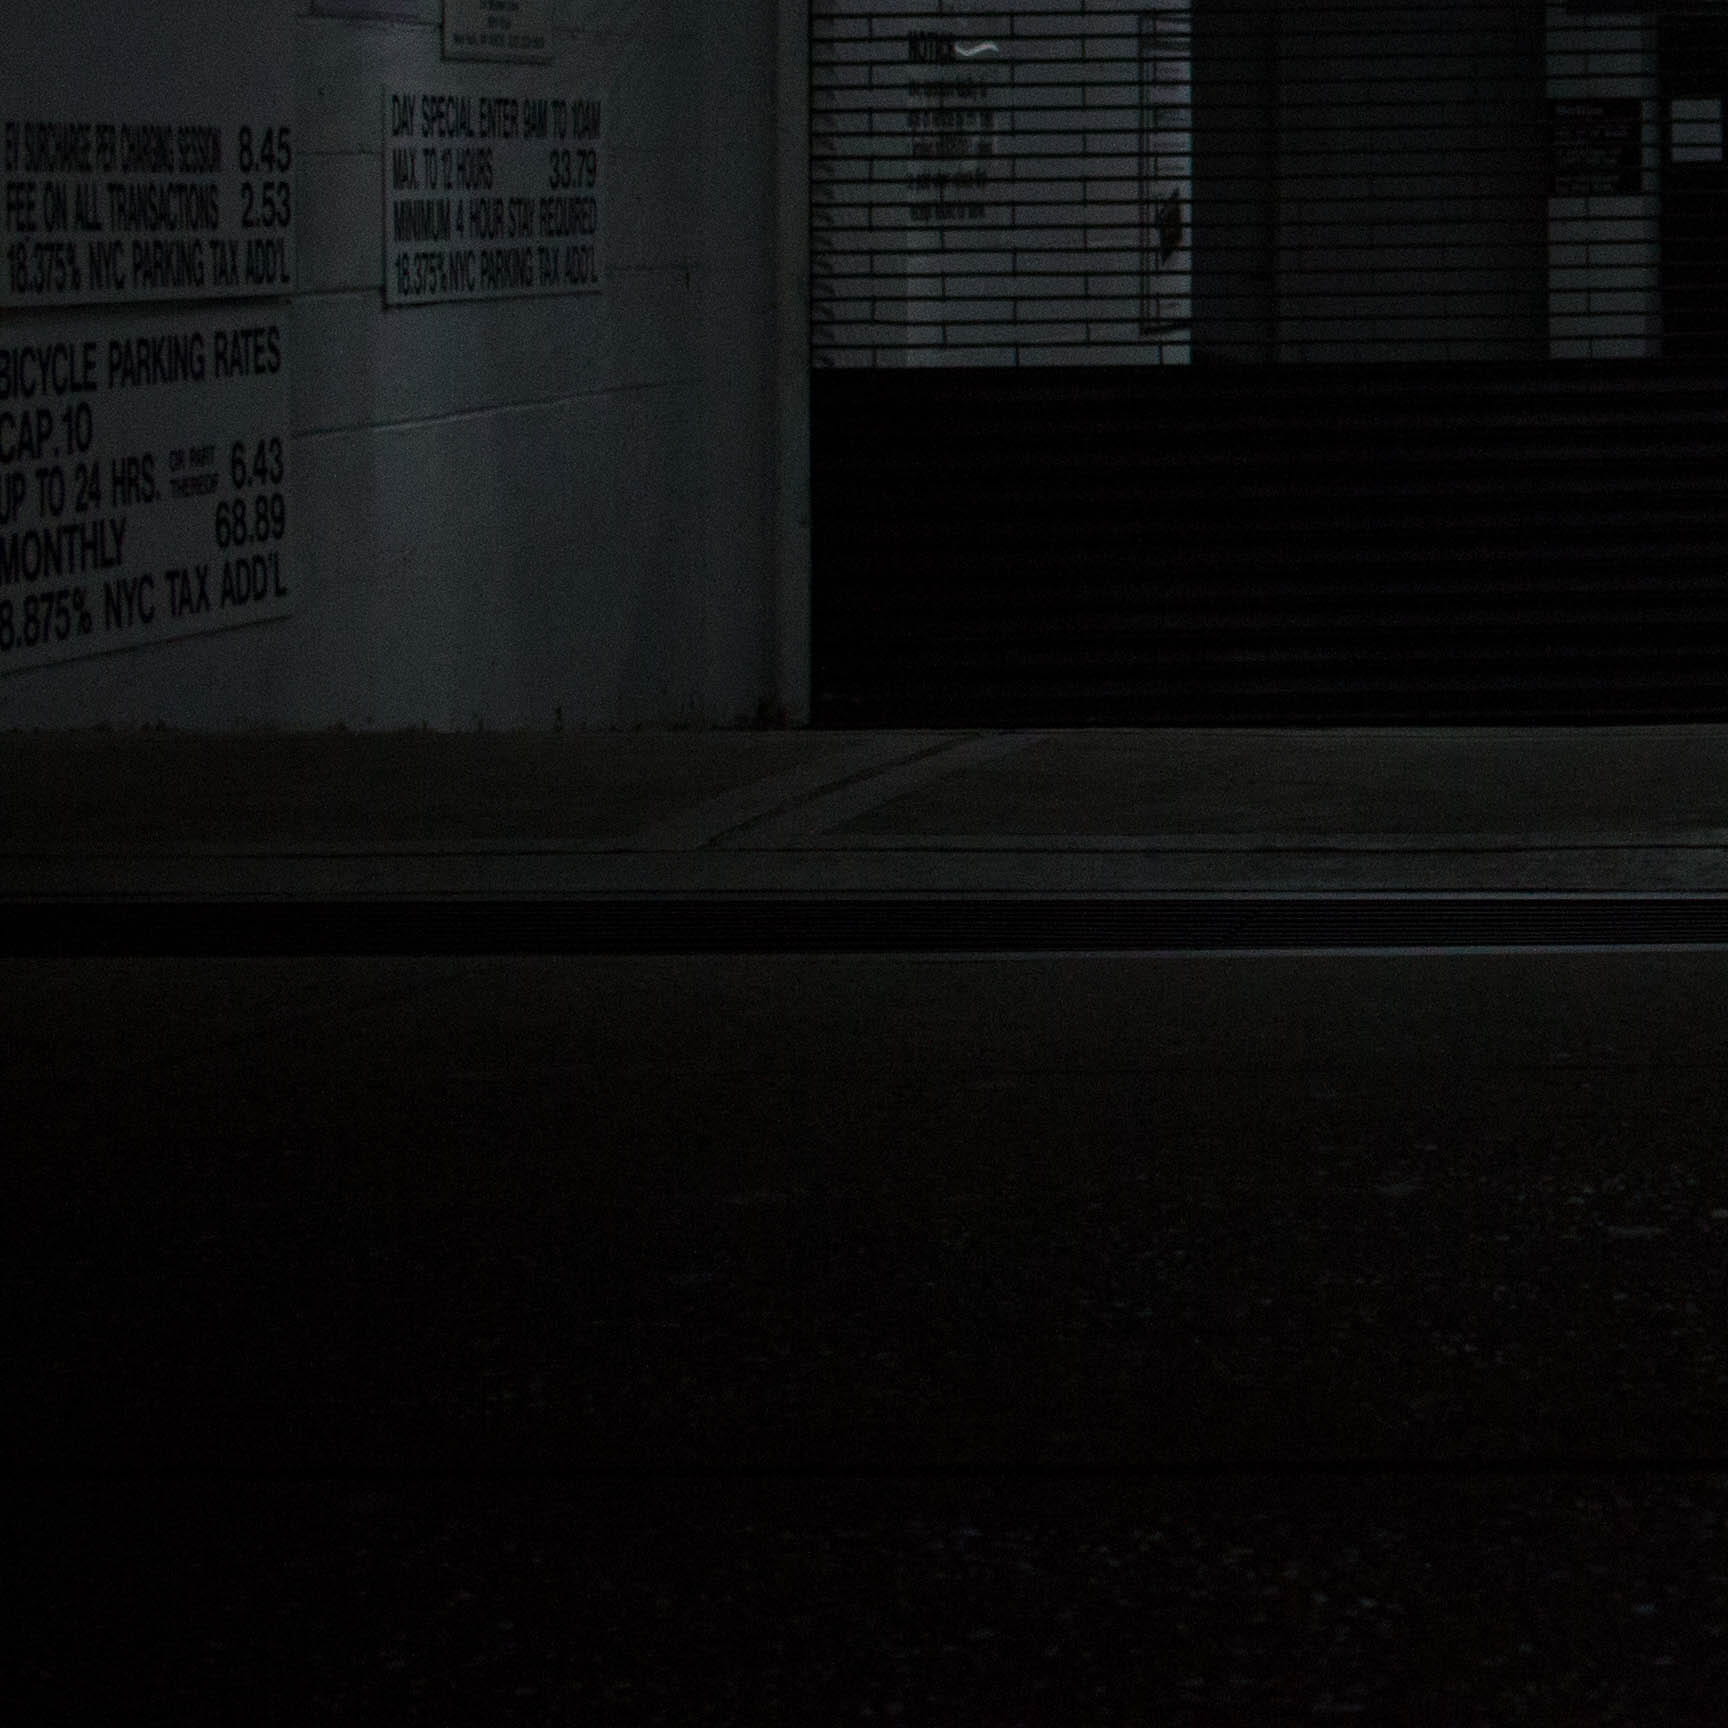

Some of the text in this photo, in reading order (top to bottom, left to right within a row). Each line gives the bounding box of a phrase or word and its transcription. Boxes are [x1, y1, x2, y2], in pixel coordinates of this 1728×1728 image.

[391, 94, 416, 137] DAY
[420, 95, 476, 139] SPECIAL
[478, 96, 519, 140] ENTER
[551, 99, 567, 141] TO
[237, 124, 293, 174] 8.45
[422, 147, 438, 191] TO
[455, 147, 494, 191] HOURS
[548, 147, 599, 191] 33.79
[6, 179, 293, 233] FEE ON ALL TRANSACTIONS 2.53
[392, 198, 451, 243] MINIMUM
[507, 196, 536, 240] STAY
[538, 195, 599, 237] REQUIRED
[88, 238, 126, 291] NYC
[131, 237, 205, 290] PARKING
[208, 237, 240, 288] TAX
[449, 248, 477, 293] NYC
[479, 245, 535, 291] PARKING
[537, 244, 561, 288] TAX
[0, 325, 283, 402] BICYCLE PARKING RATES
[35, 465, 66, 518] TO
[73, 459, 102, 514] 24
[110, 453, 161, 508] HRS.
[229, 436, 285, 491] 6.43
[0, 491, 288, 586] MONTHLY 68.89
[103, 573, 156, 631] NYC
[164, 563, 211, 619] TAX
[219, 550, 289, 610] ADD'L
